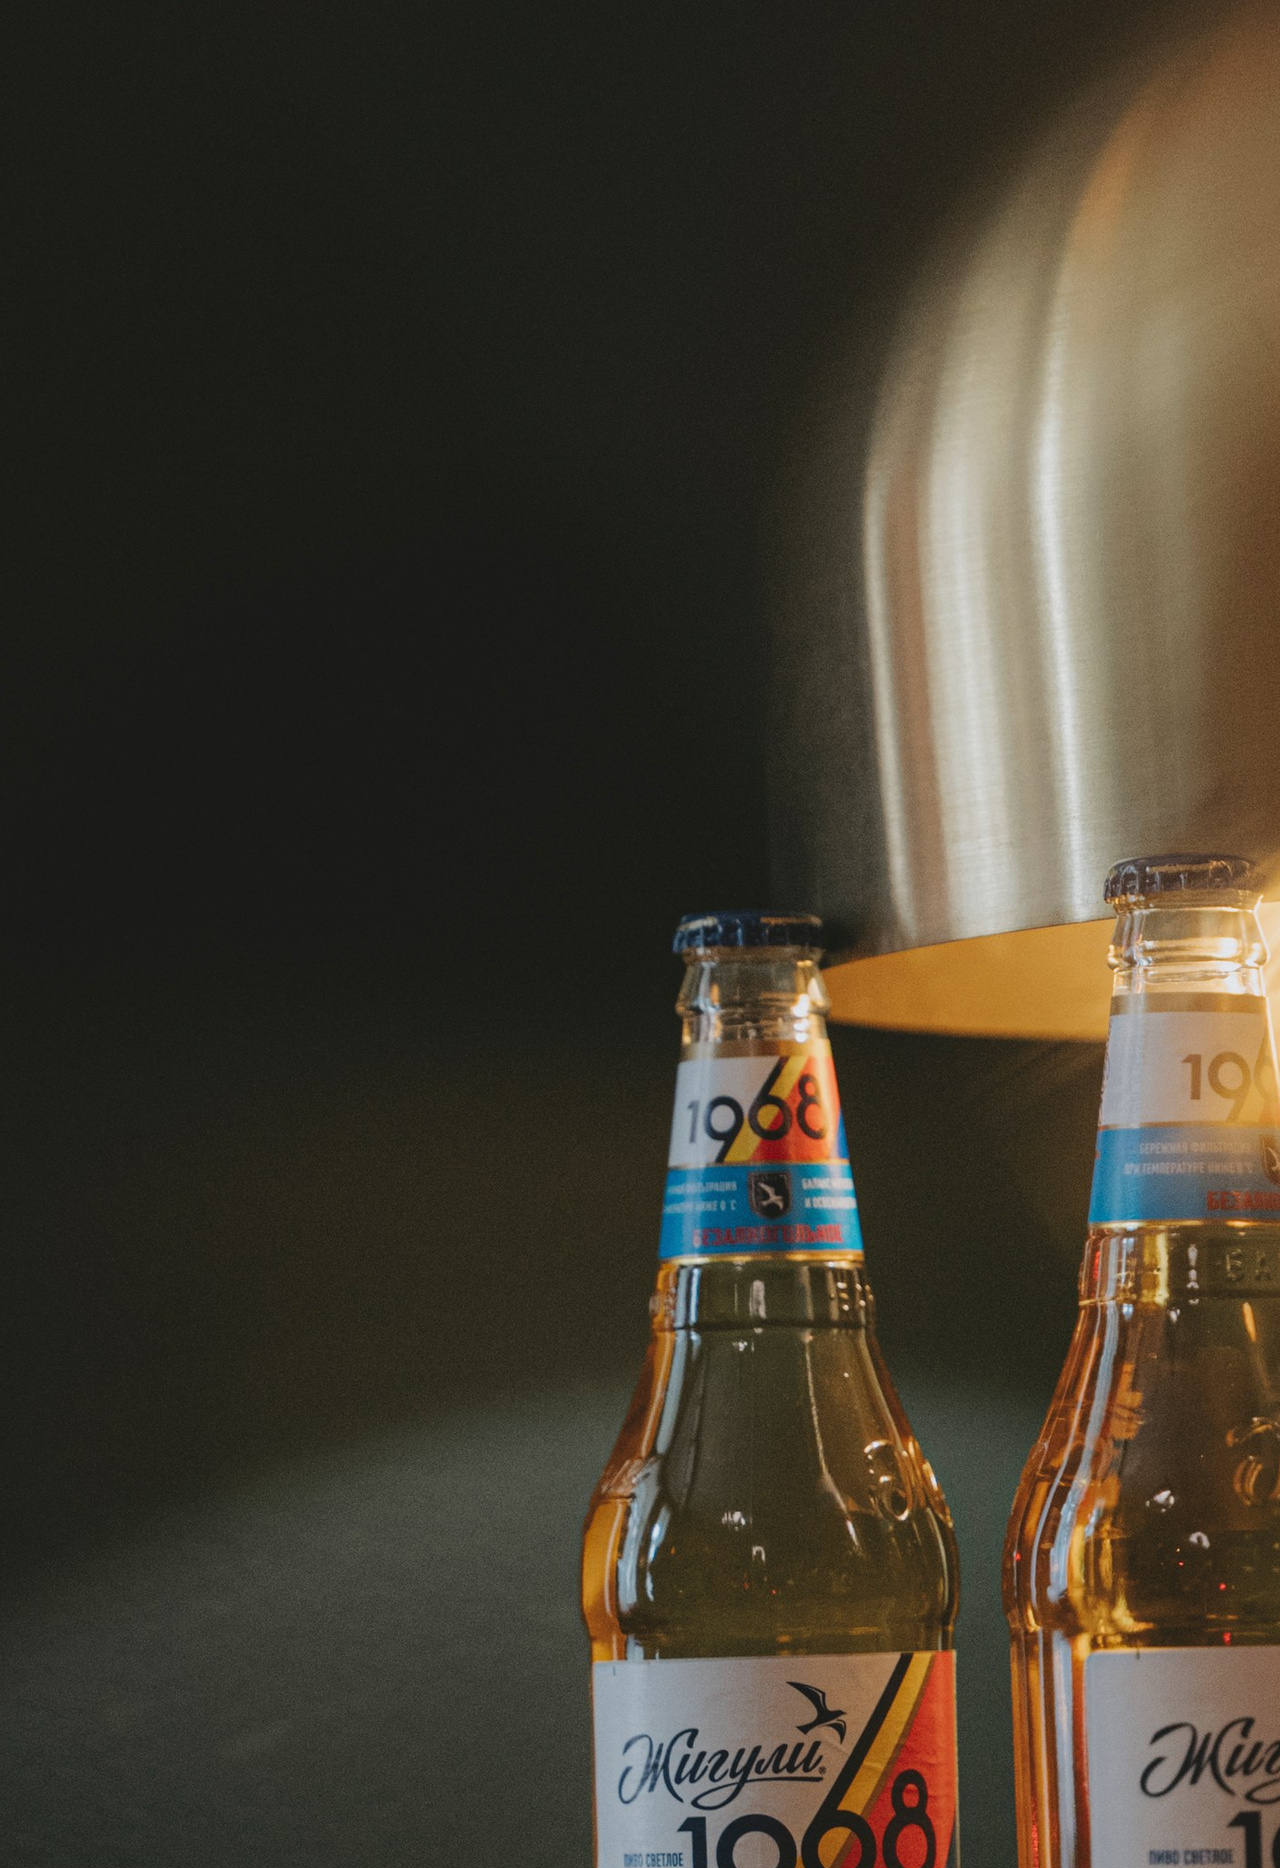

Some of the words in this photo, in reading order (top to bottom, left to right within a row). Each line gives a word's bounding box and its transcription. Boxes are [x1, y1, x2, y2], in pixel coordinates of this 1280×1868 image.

[686, 1056, 828, 1163] 1968
[693, 1223, 843, 1248] БЕЗАЛКОГОЛЬНОЕ
[645, 1852, 684, 1868] СВЕТЛОЕ
